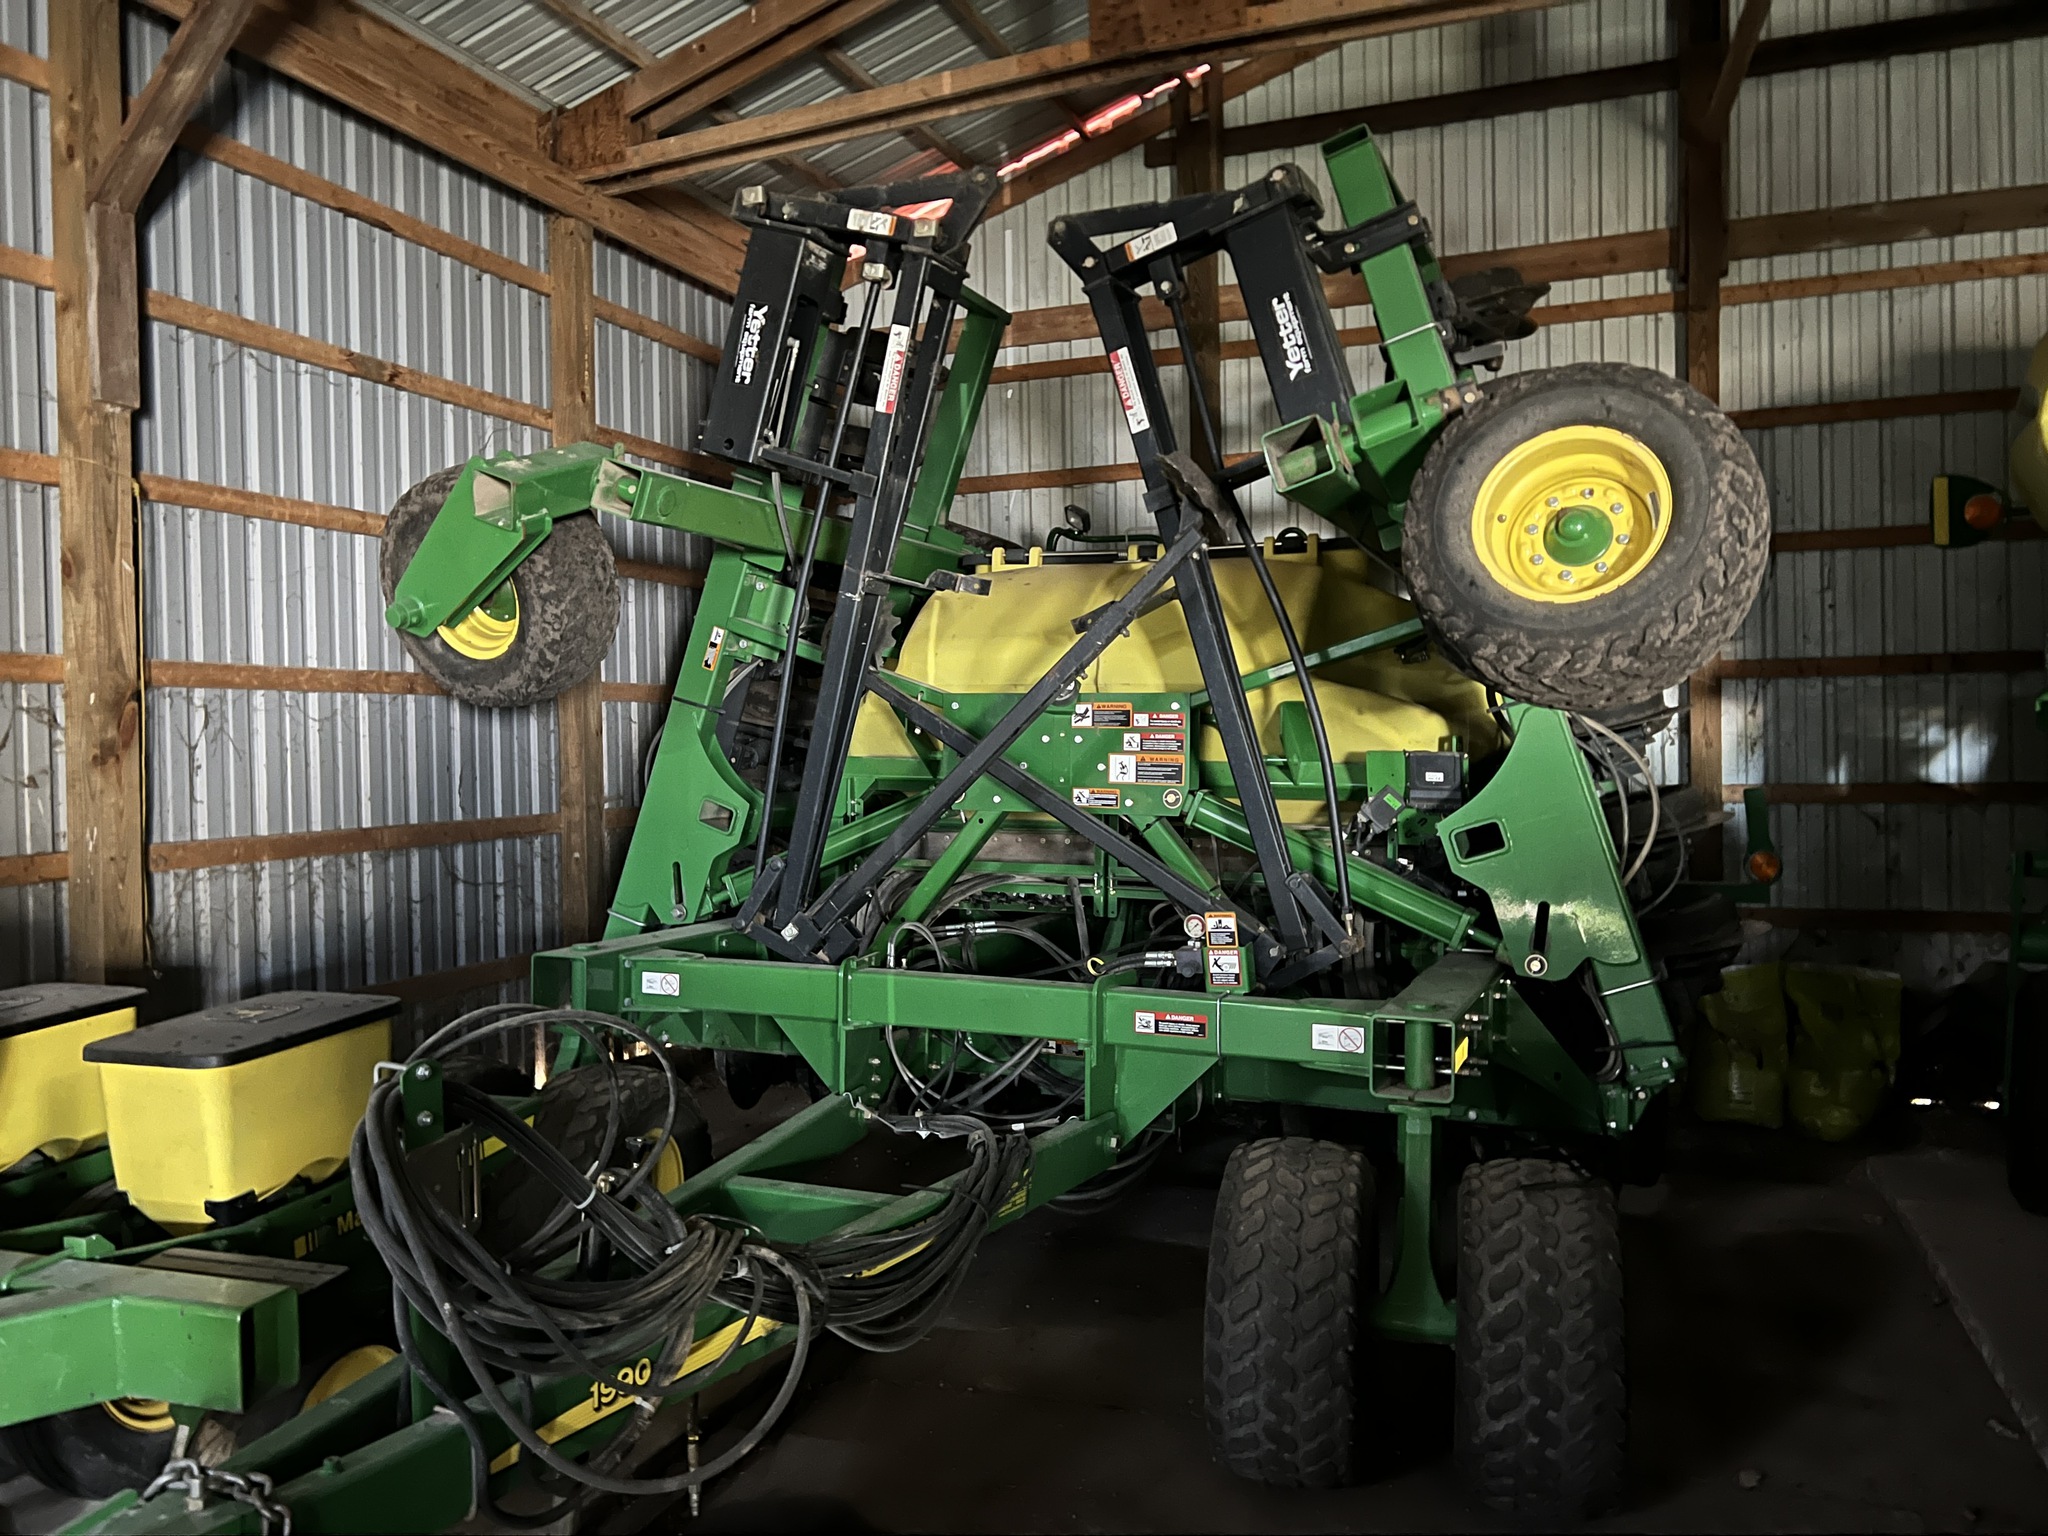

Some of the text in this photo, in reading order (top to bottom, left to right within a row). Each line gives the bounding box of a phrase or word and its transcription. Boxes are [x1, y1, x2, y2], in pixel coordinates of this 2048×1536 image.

[742, 304, 769, 385] Yetter
[1271, 297, 1304, 382] Yetter
[887, 363, 902, 401] DANGER
[1113, 361, 1130, 400] DANGER
